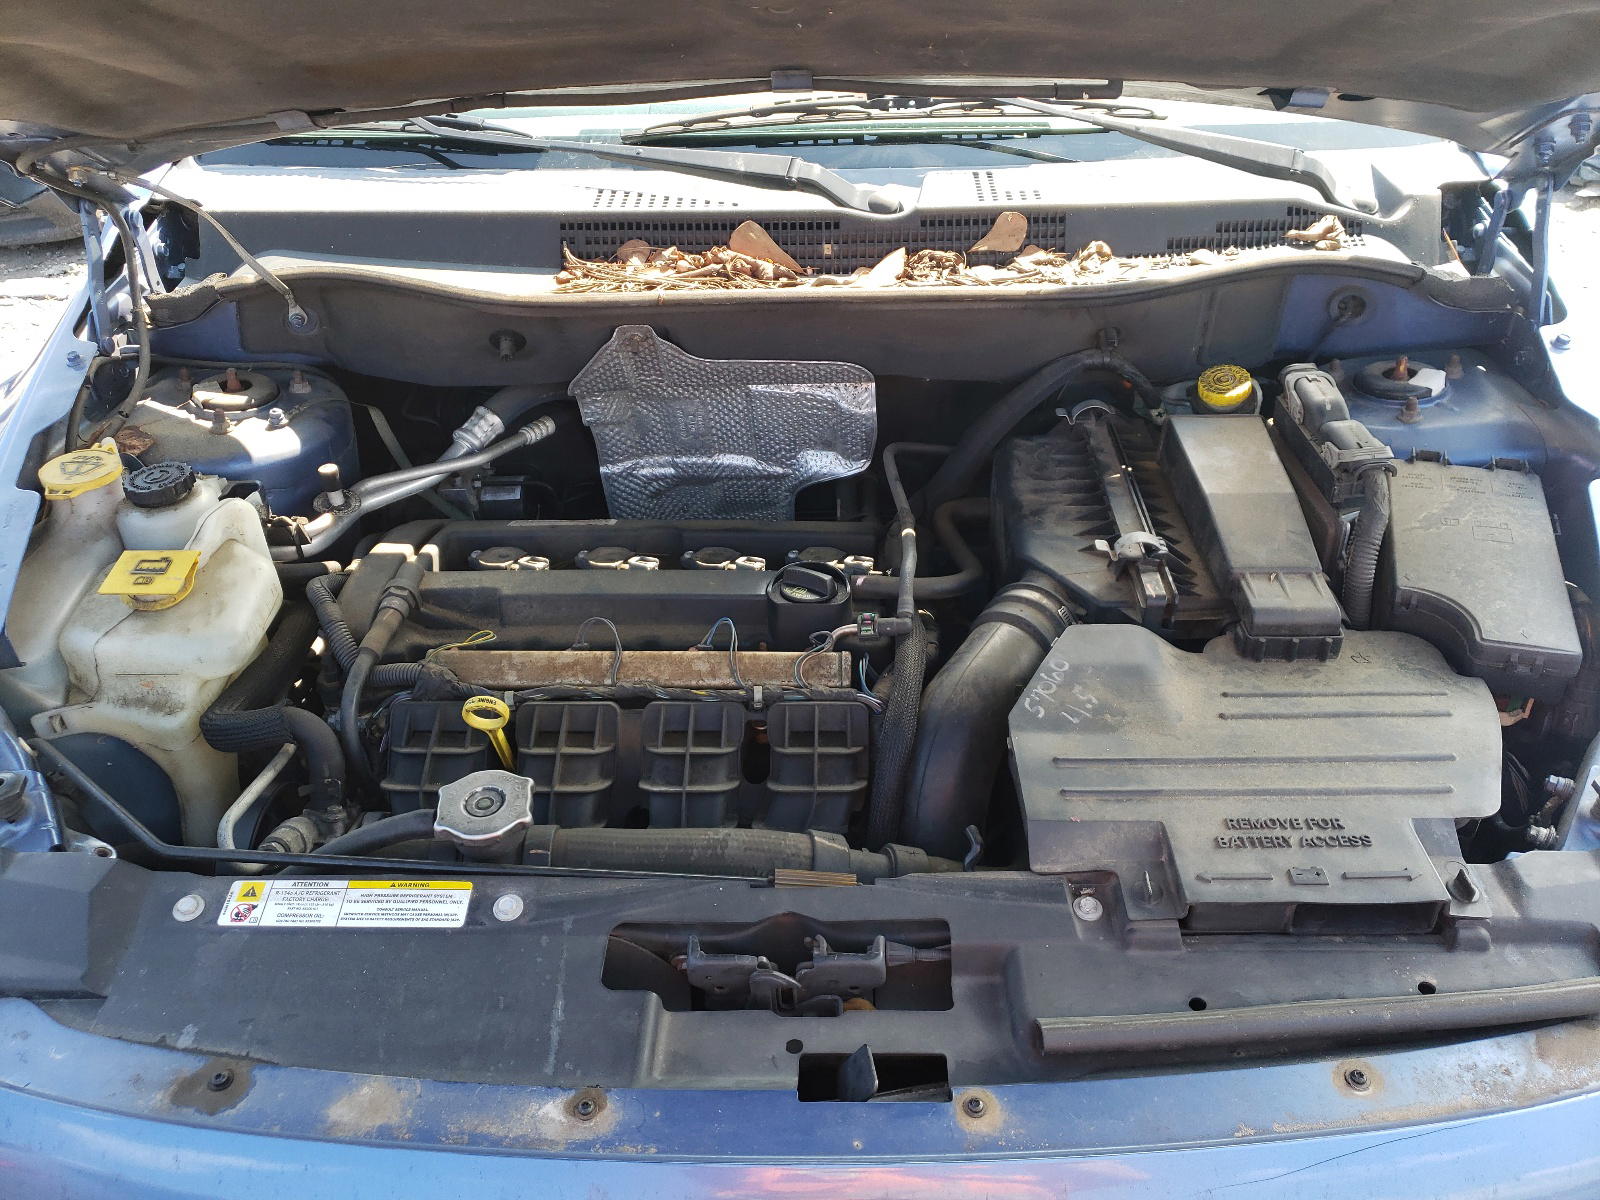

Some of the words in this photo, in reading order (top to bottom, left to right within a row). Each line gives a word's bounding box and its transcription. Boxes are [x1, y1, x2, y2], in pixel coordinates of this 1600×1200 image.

[1225, 816, 1303, 831] REMOVE
[1305, 816, 1346, 831] FOR
[1214, 835, 1294, 849] BATTERY
[1300, 834, 1373, 848] ACCESS
